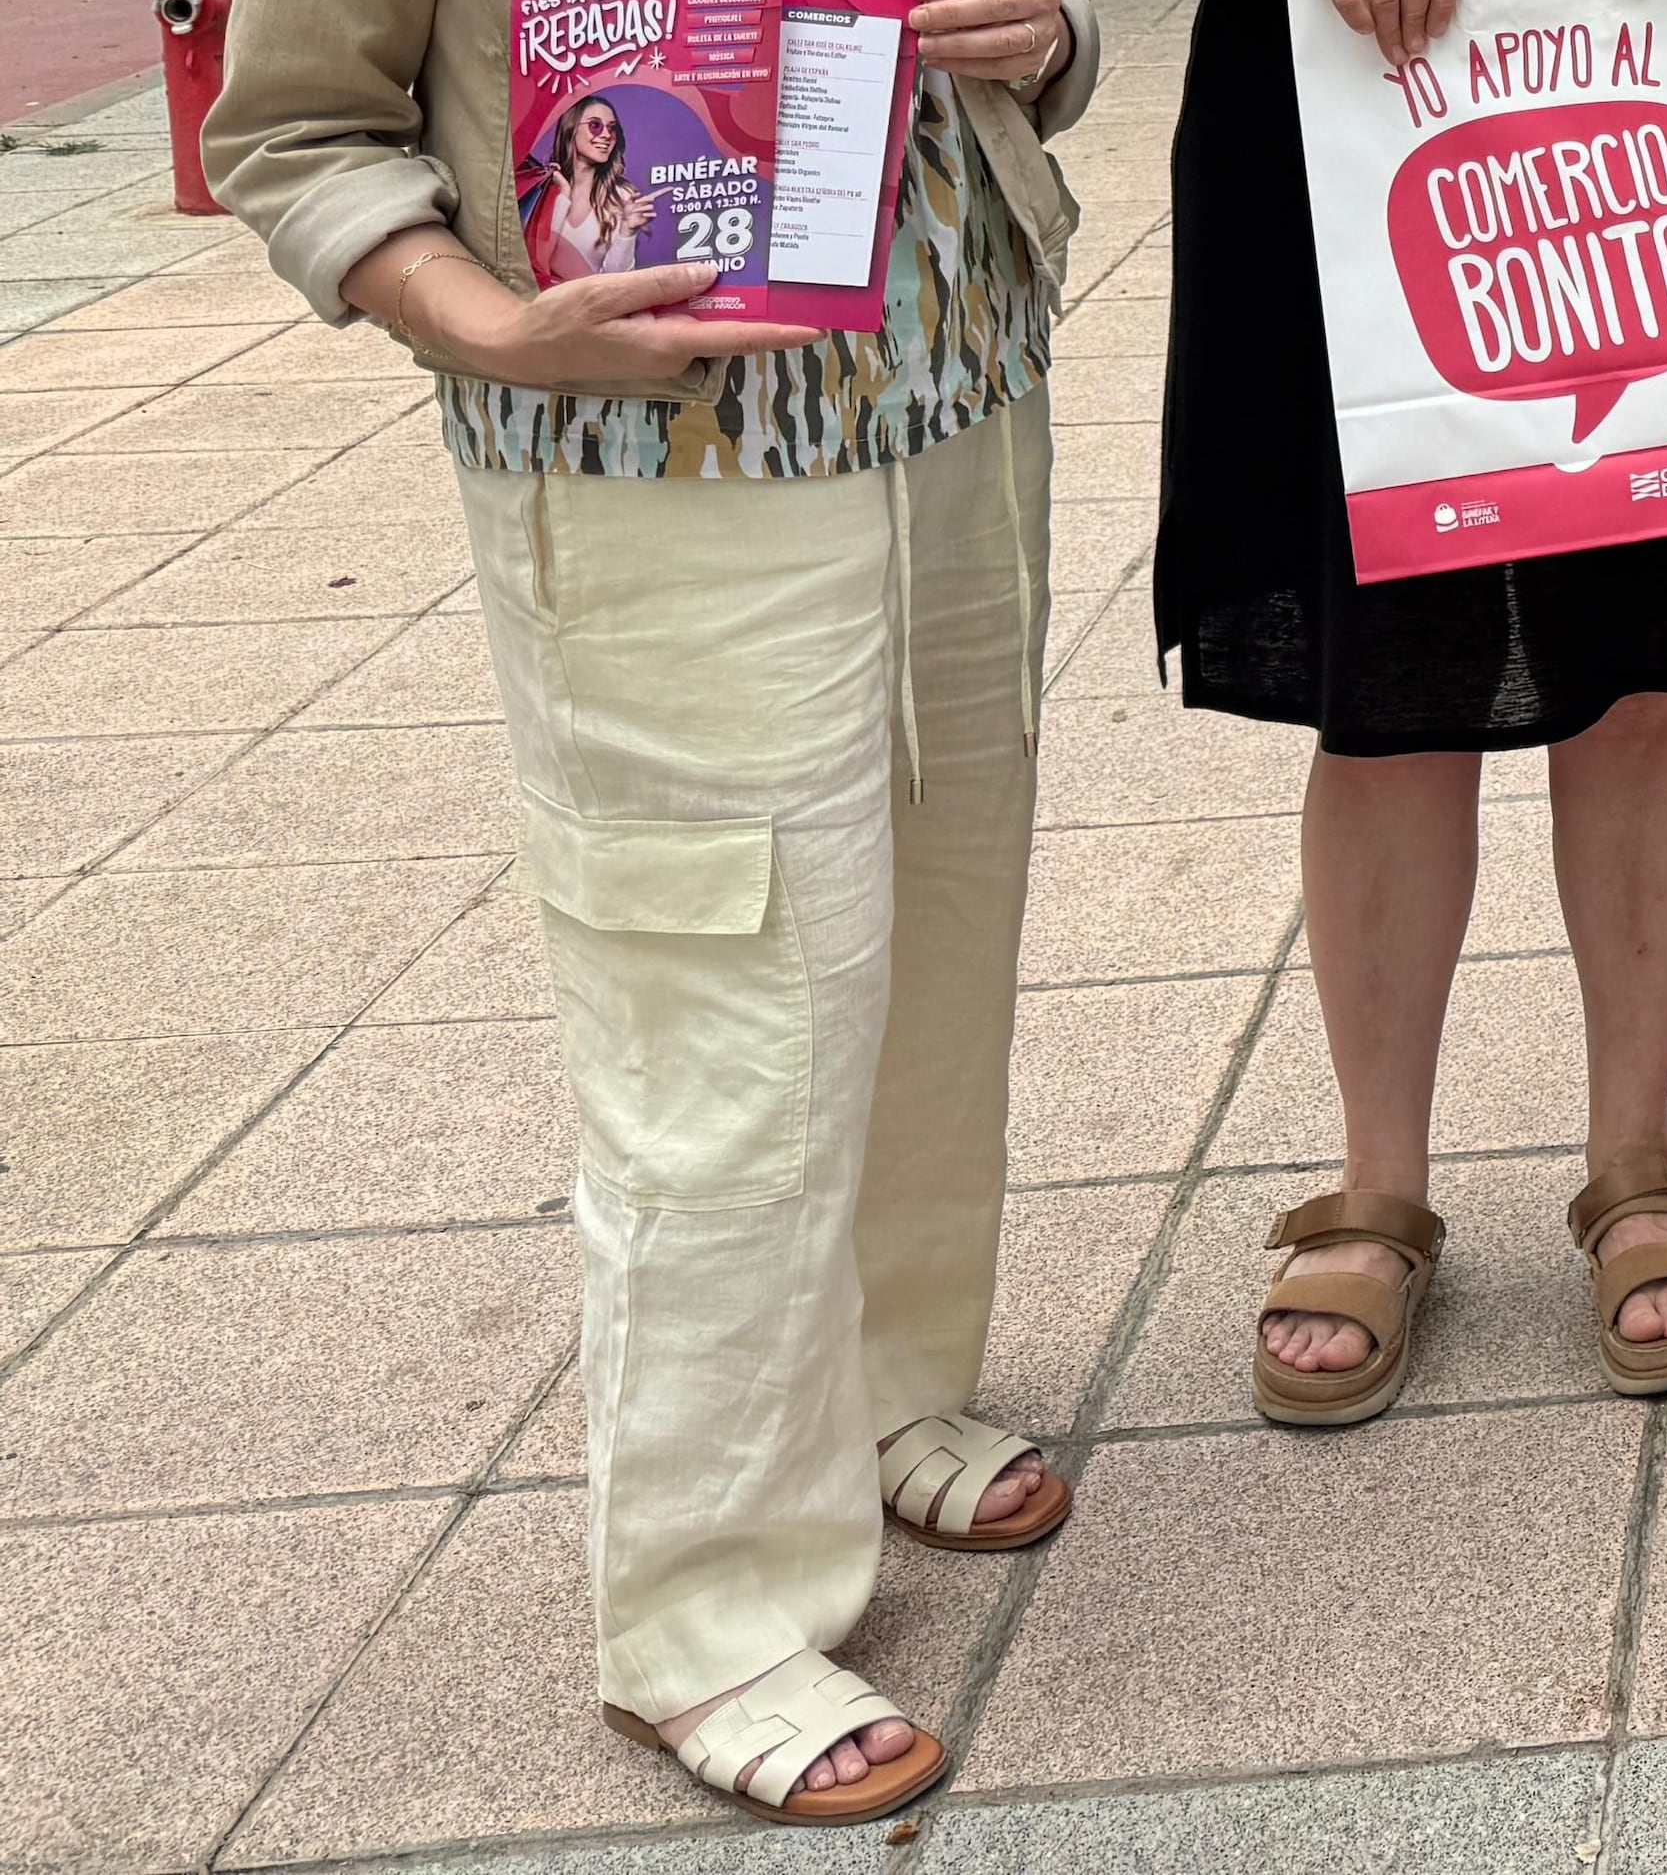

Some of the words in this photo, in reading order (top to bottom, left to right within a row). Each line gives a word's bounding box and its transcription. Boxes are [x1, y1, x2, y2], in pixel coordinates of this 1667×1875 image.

[788, 11, 851, 24] COMERCIOS
[1382, 56, 1449, 129] YO
[1468, 23, 1592, 105] APOYO
[1611, 20, 1661, 88] AL
[651, 156, 758, 185] BINÉFAR
[672, 179, 758, 202] SÁBADO
[670, 201, 701, 213] 10:00
[703, 200, 713, 211] A
[715, 195, 747, 209] 13:30
[676, 208, 754, 262] 28
